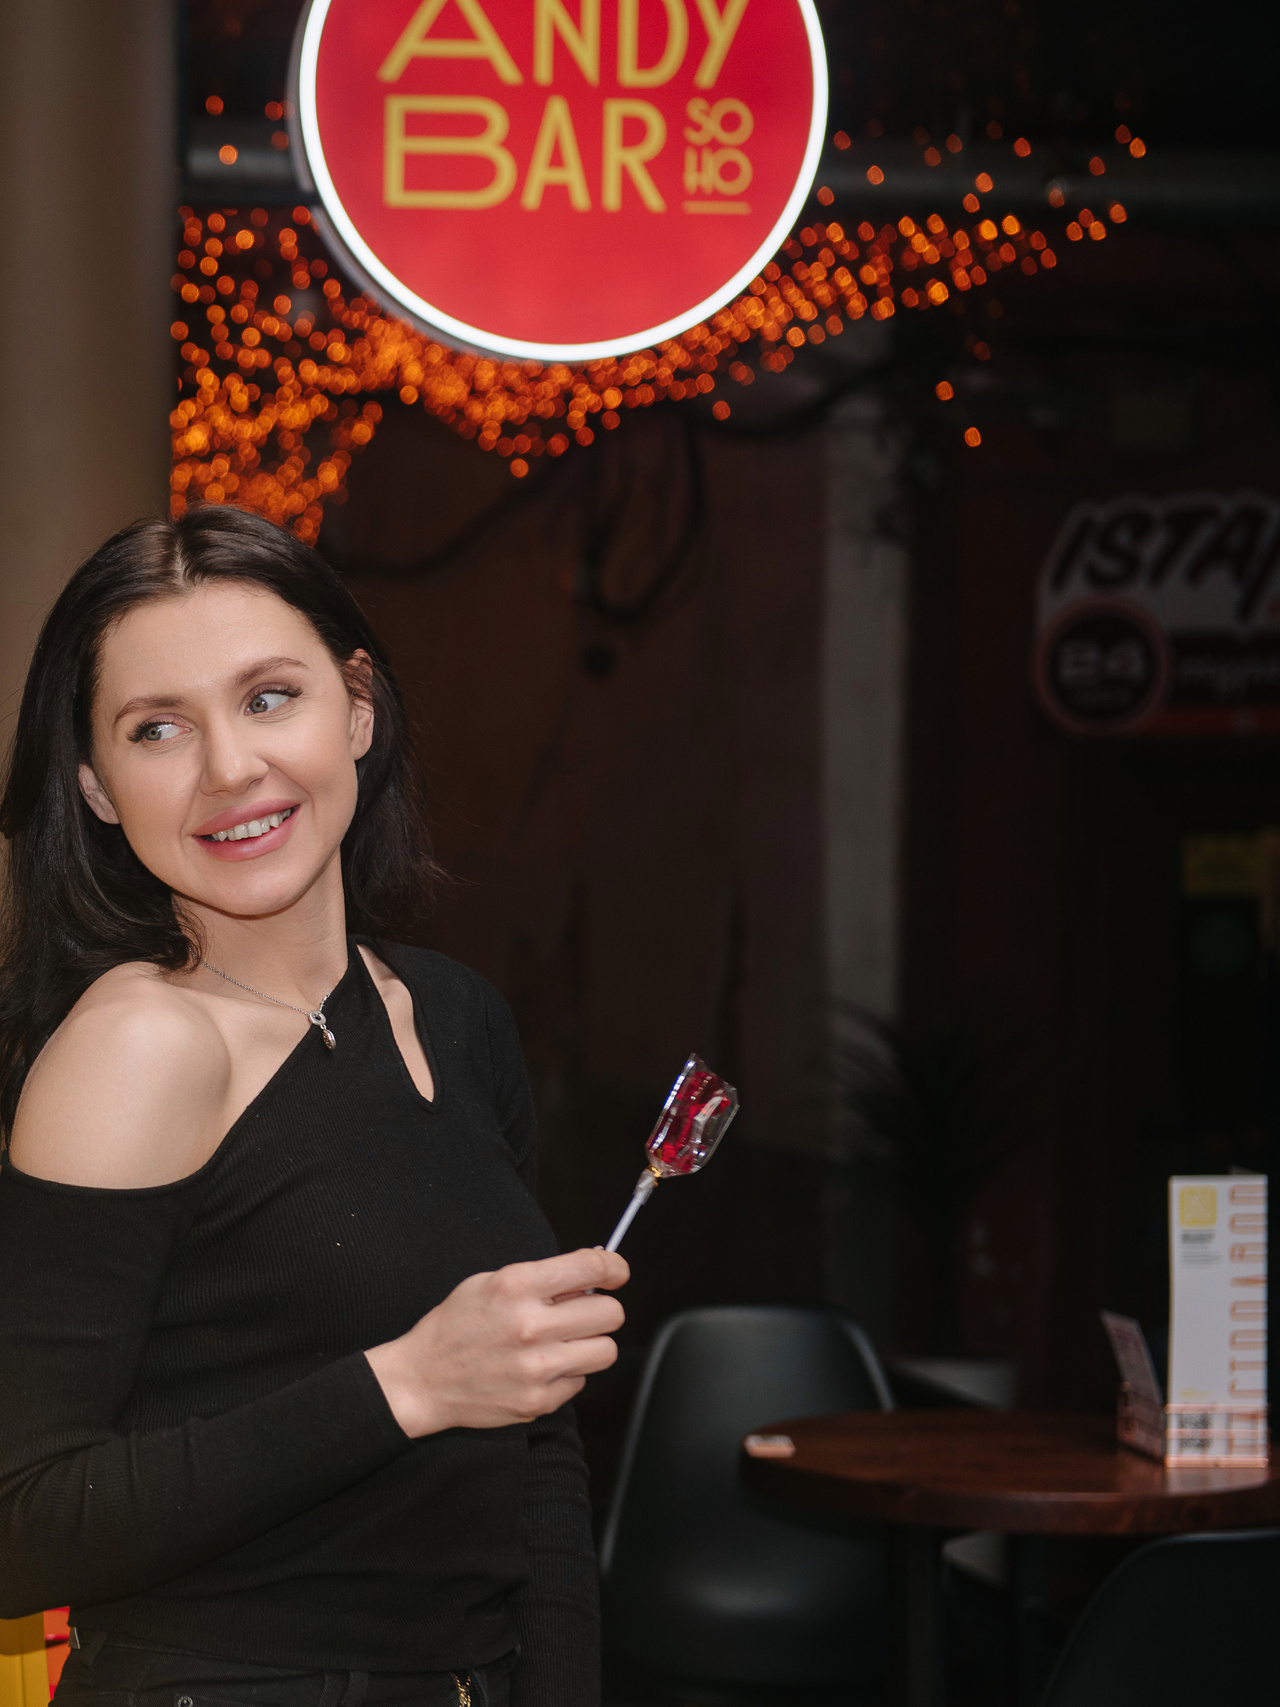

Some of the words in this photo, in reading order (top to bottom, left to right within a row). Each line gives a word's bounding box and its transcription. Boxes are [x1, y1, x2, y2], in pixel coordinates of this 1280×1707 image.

[376, 0, 752, 88] ANDY
[382, 94, 667, 213] BAR
[682, 97, 754, 146] SO
[682, 146, 753, 196] HO
